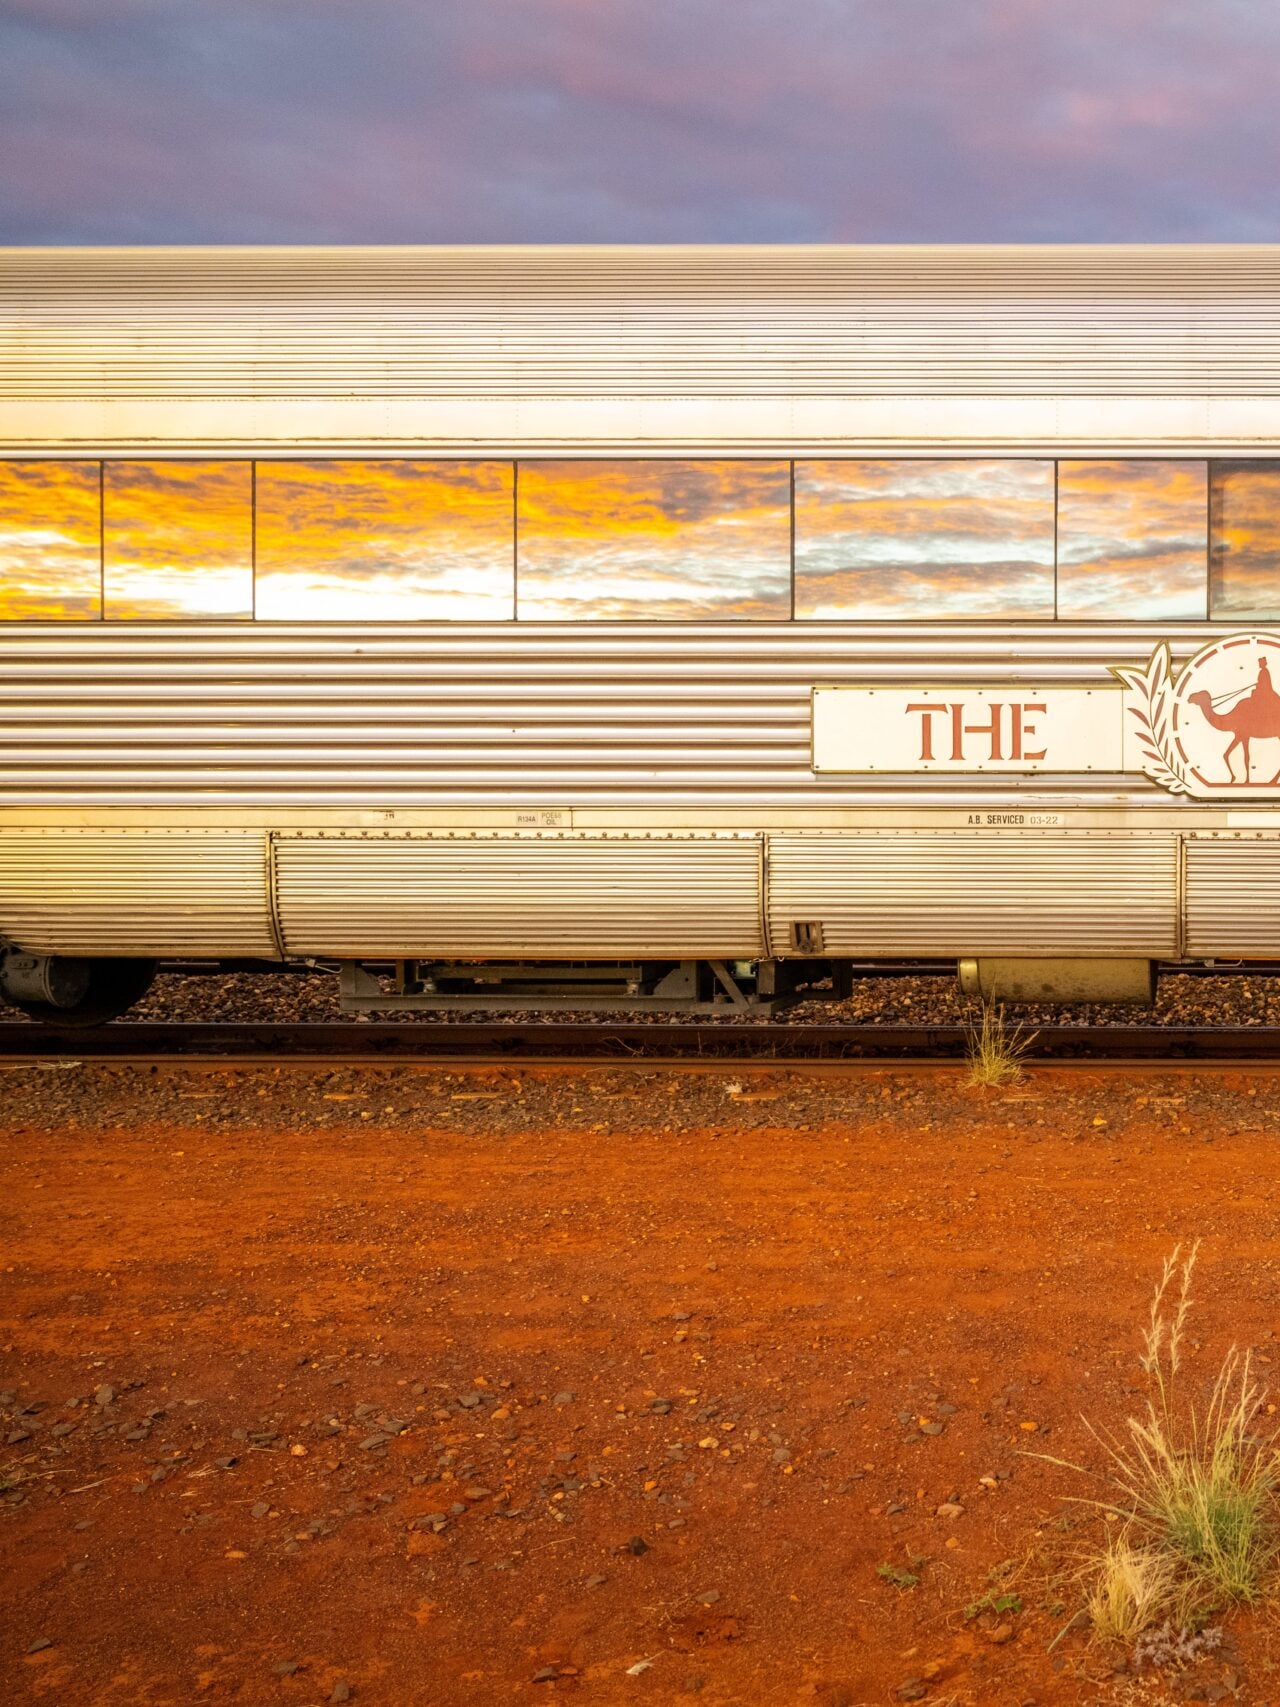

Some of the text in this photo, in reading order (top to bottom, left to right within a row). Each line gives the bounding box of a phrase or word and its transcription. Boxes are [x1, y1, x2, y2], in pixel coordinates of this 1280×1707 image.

[905, 703, 1048, 761] THE
[968, 814, 1059, 825] A.B. SERVICED 03-22
